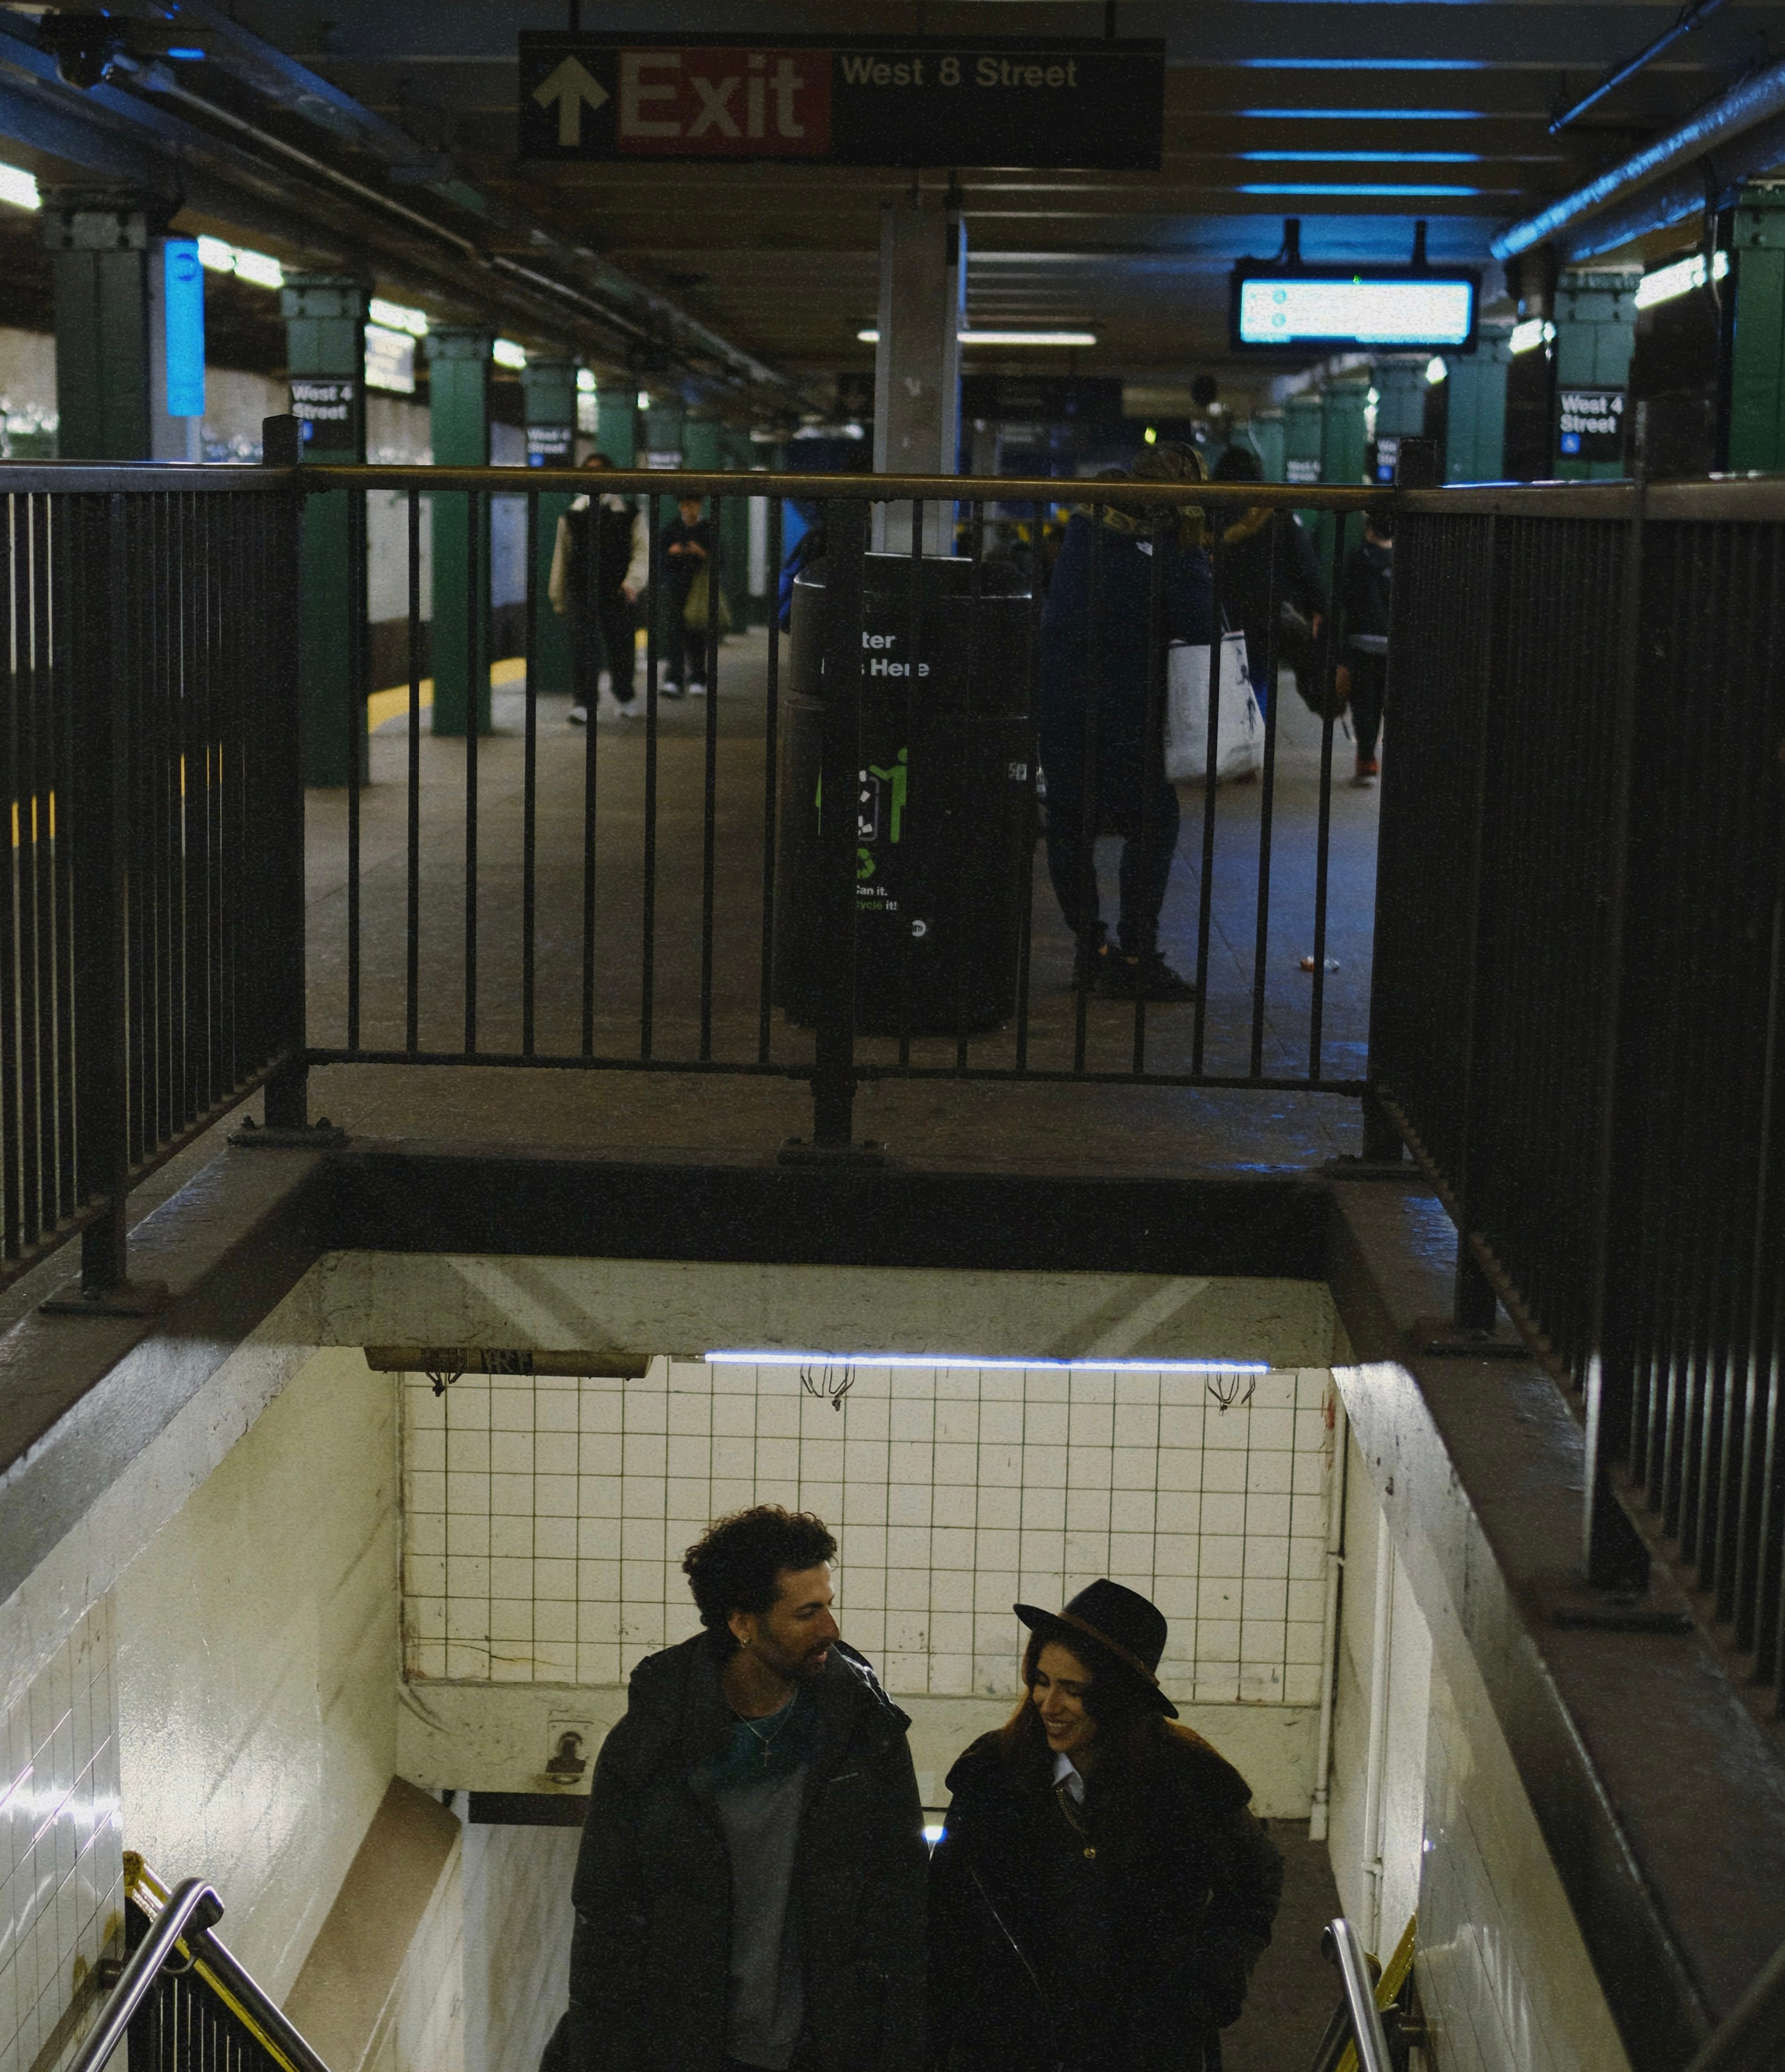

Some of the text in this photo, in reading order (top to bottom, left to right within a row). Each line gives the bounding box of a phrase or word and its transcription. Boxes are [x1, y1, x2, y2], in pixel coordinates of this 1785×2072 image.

[841, 56, 1077, 87] West 8 Street
[620, 52, 805, 137] Exit
[291, 385, 353, 402] West 4
[292, 402, 348, 420] Street
[1560, 395, 1624, 415] West 4
[1560, 414, 1617, 433] Street
[861, 631, 897, 649] ter
[876, 886, 888, 896] it.
[856, 900, 897, 910] ycle it!
